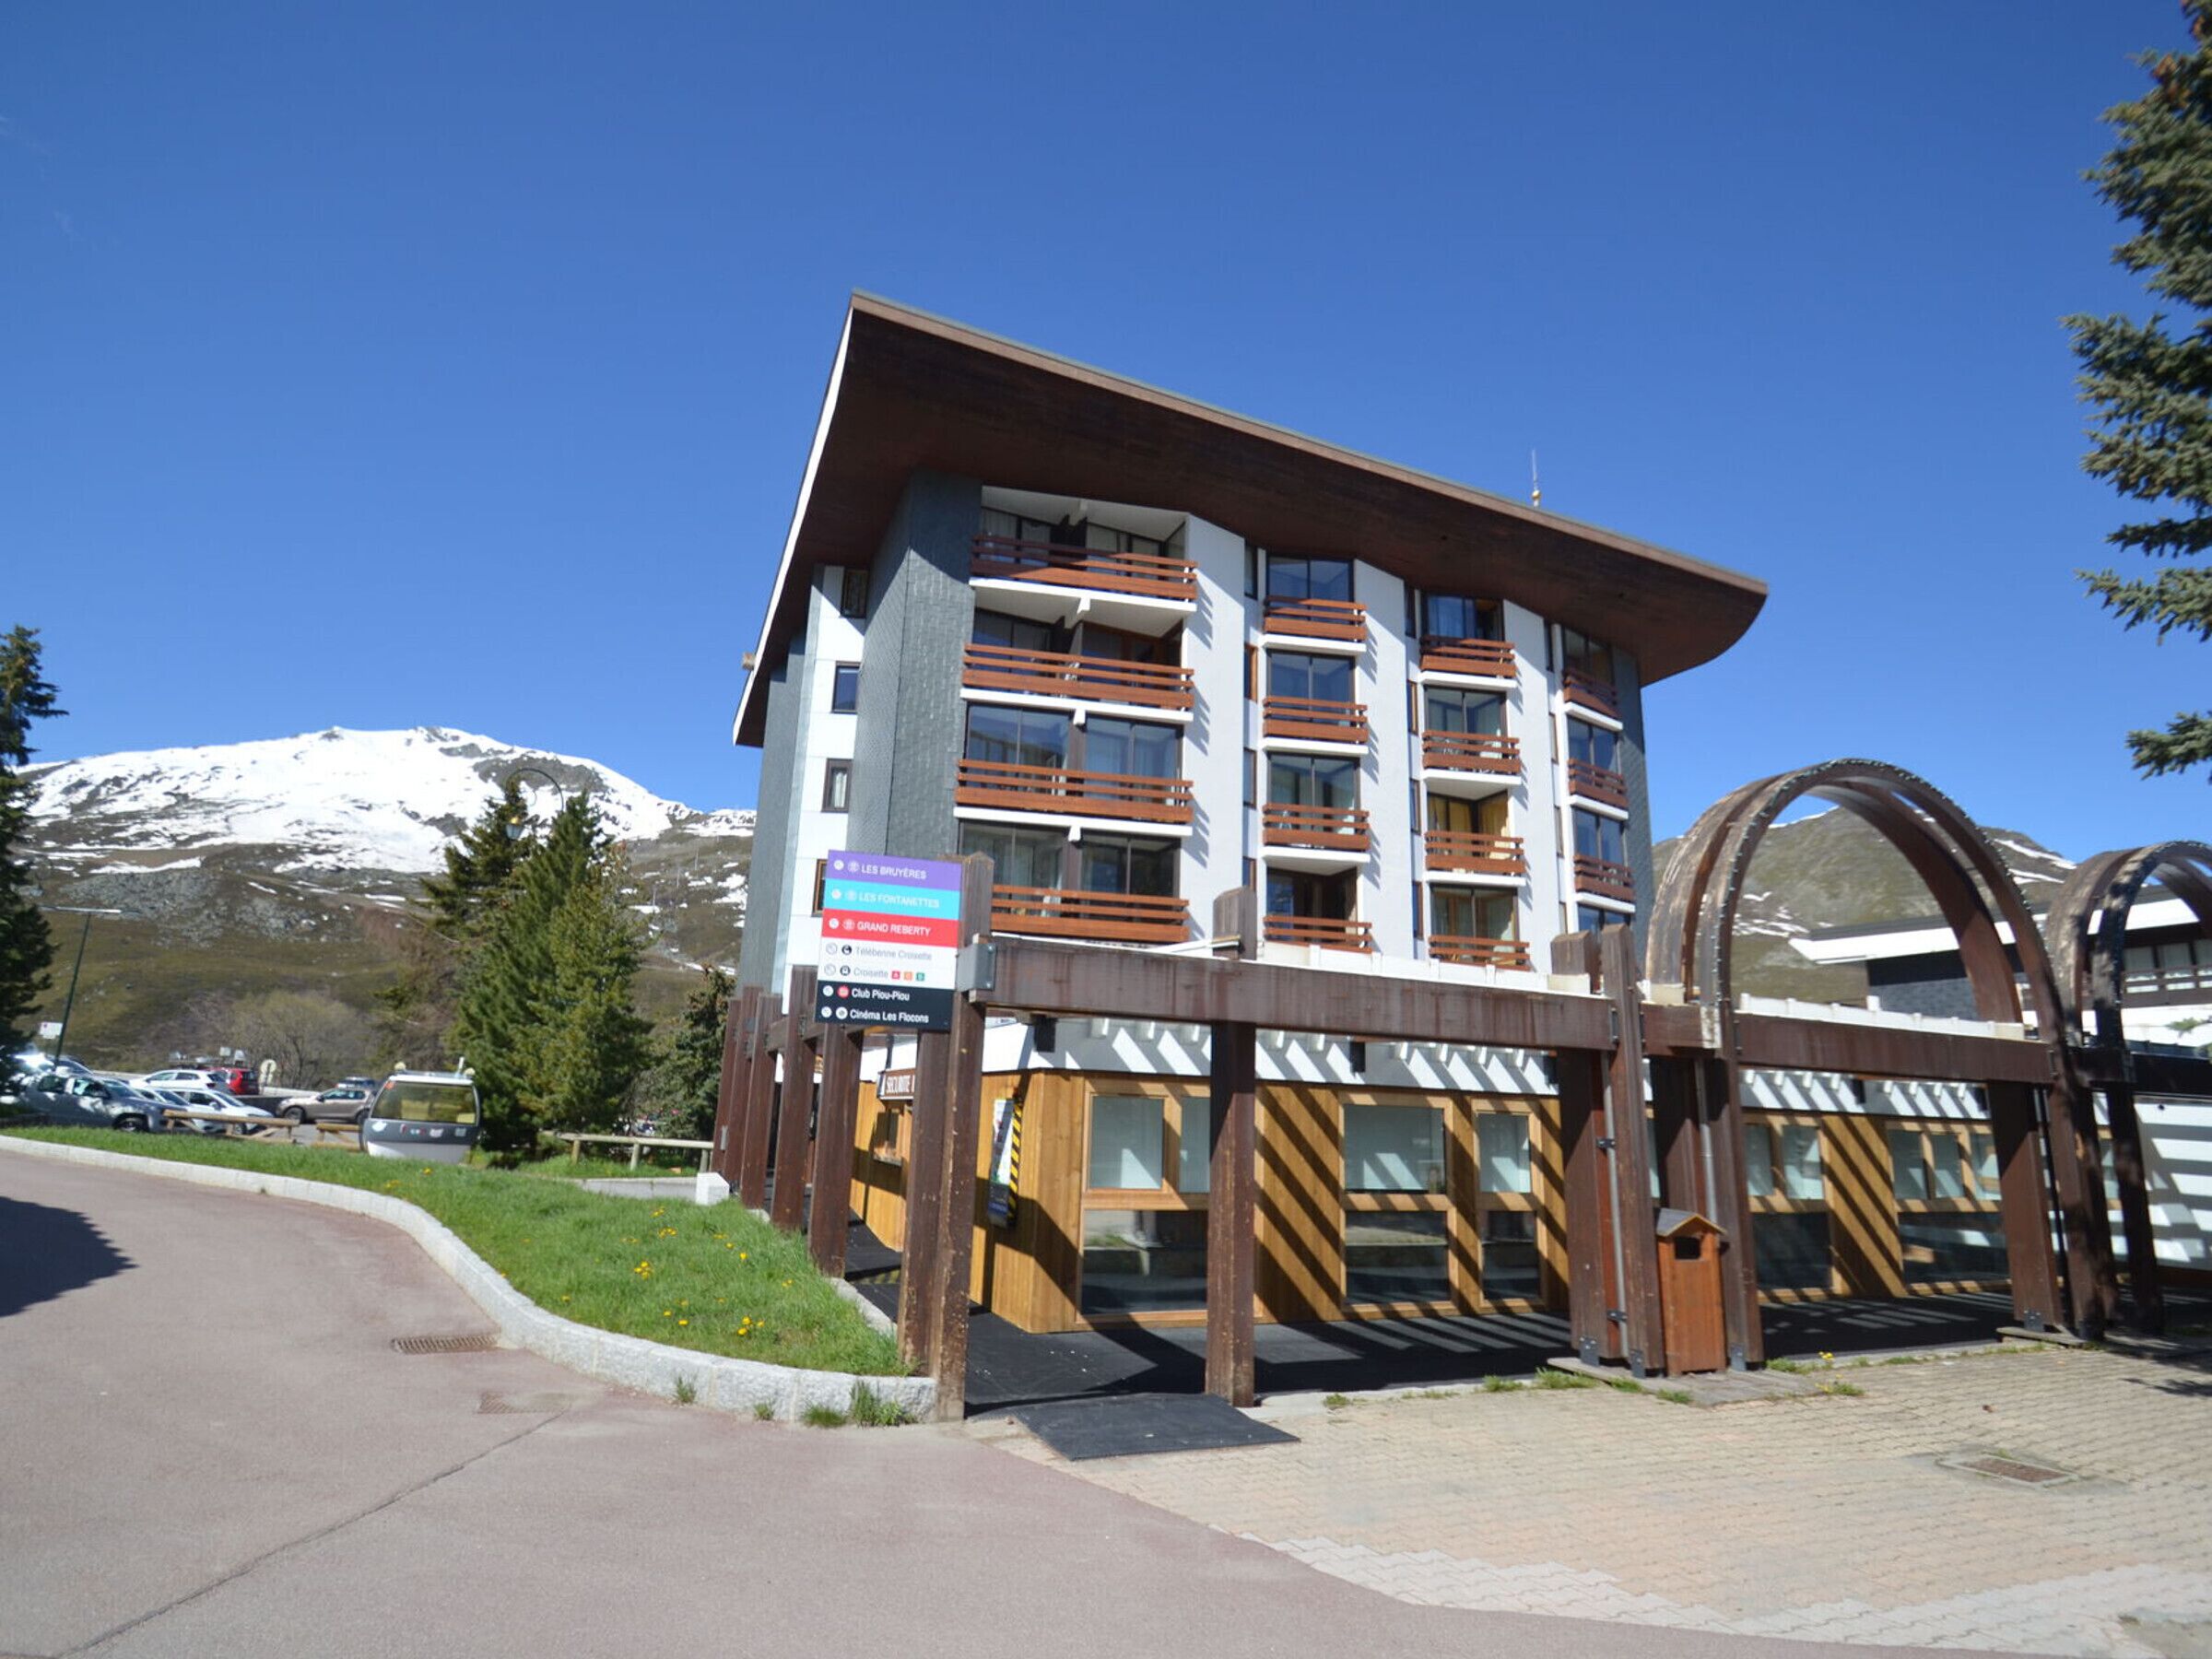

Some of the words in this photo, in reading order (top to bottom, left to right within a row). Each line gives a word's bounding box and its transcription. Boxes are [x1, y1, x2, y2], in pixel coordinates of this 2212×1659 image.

[861, 865, 878, 875] LES
[859, 892, 876, 902] LES
[857, 921, 888, 933] GRAND
[890, 925, 931, 936] REBERTY
[852, 988, 871, 999] Club
[872, 990, 910, 1001] Piou-Piou
[850, 1008, 881, 1020] Cinéma
[882, 1010, 897, 1020] Les
[898, 1012, 928, 1022] Flocons
